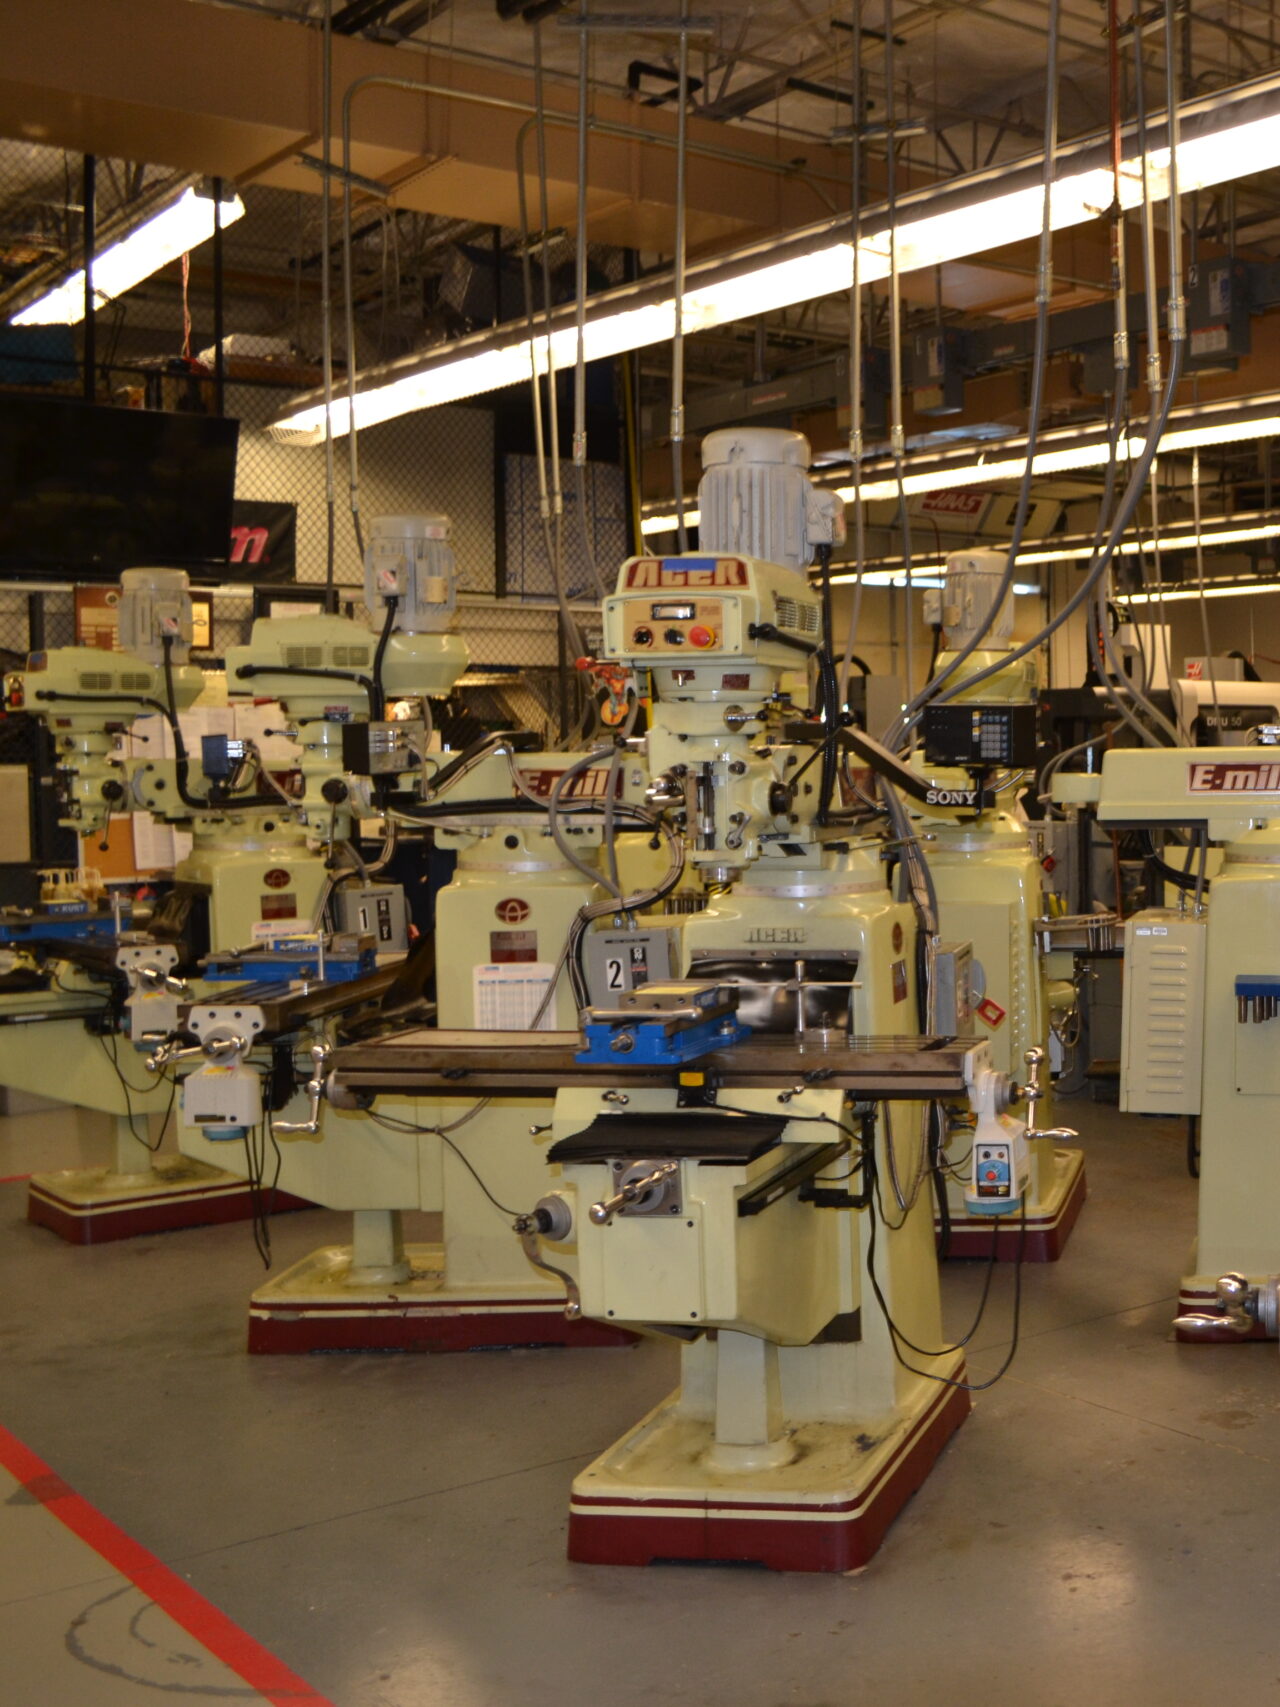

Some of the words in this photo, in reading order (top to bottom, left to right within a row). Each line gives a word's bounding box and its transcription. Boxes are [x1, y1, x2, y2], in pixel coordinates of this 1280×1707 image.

[631, 559, 742, 588] ACER
[926, 790, 977, 805] SONY
[361, 907, 368, 929] 1
[609, 960, 623, 989] 2
